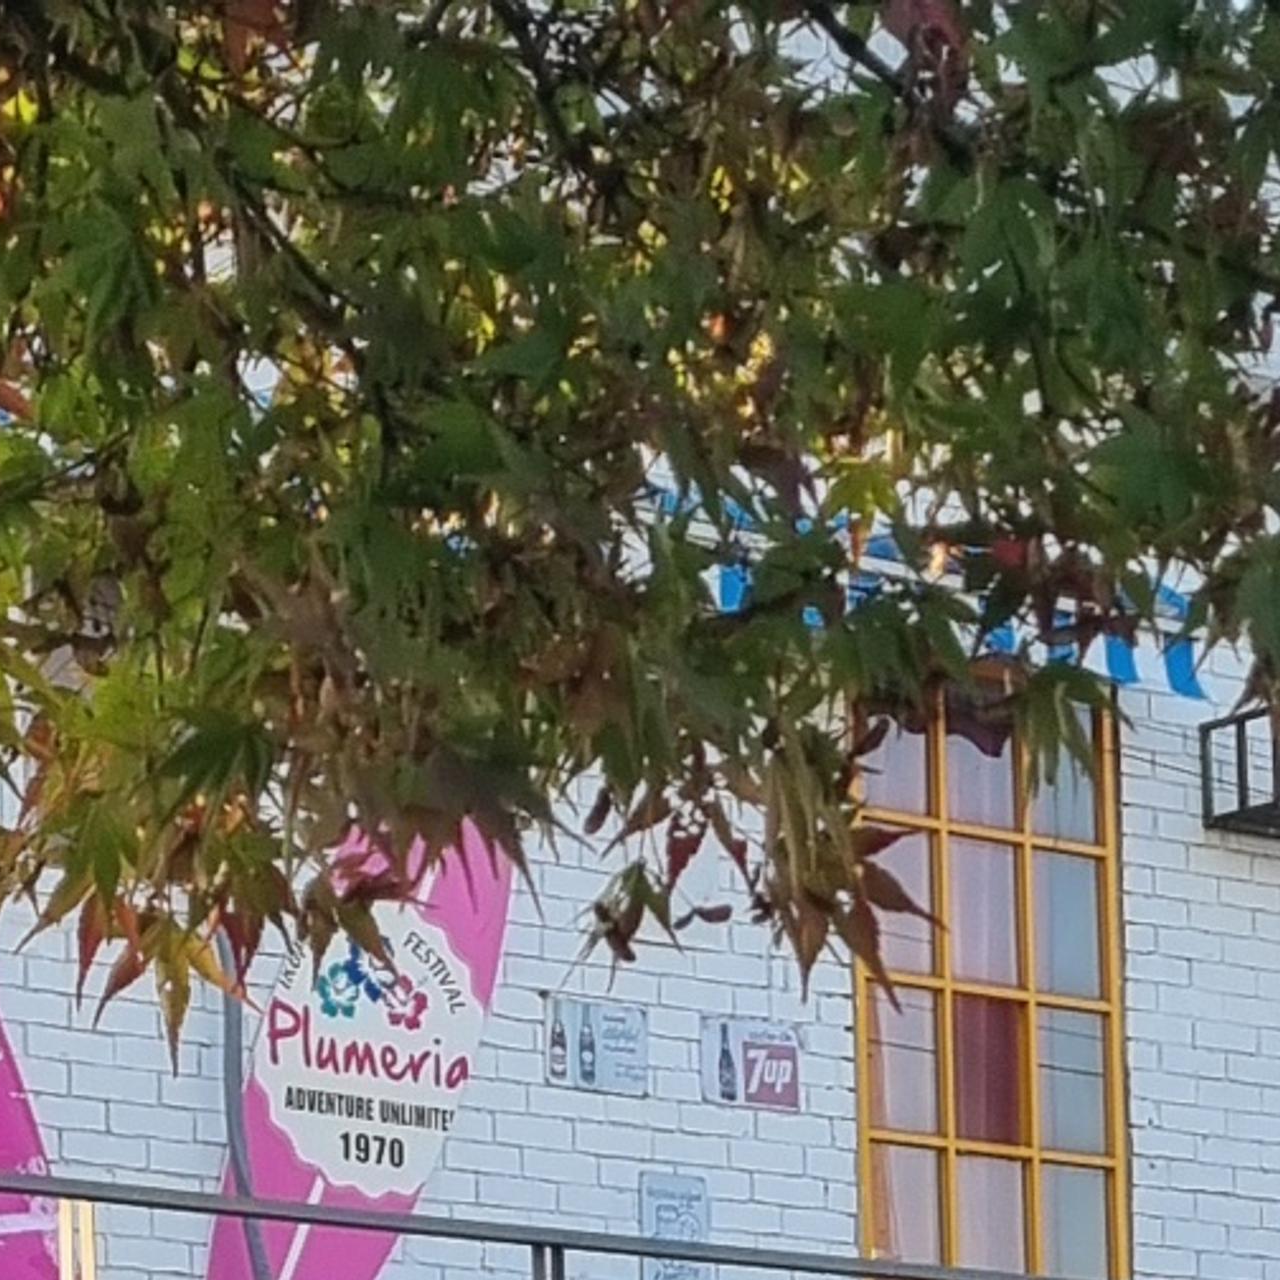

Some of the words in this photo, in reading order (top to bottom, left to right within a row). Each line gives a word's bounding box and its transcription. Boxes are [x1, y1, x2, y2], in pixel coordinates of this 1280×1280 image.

[403, 931, 466, 1015] FESTIVAL
[267, 995, 470, 1090] Plumeria
[747, 1048, 794, 1094] 7up
[284, 1086, 375, 1121] ADVENTURE
[339, 1131, 405, 1168] 1970
